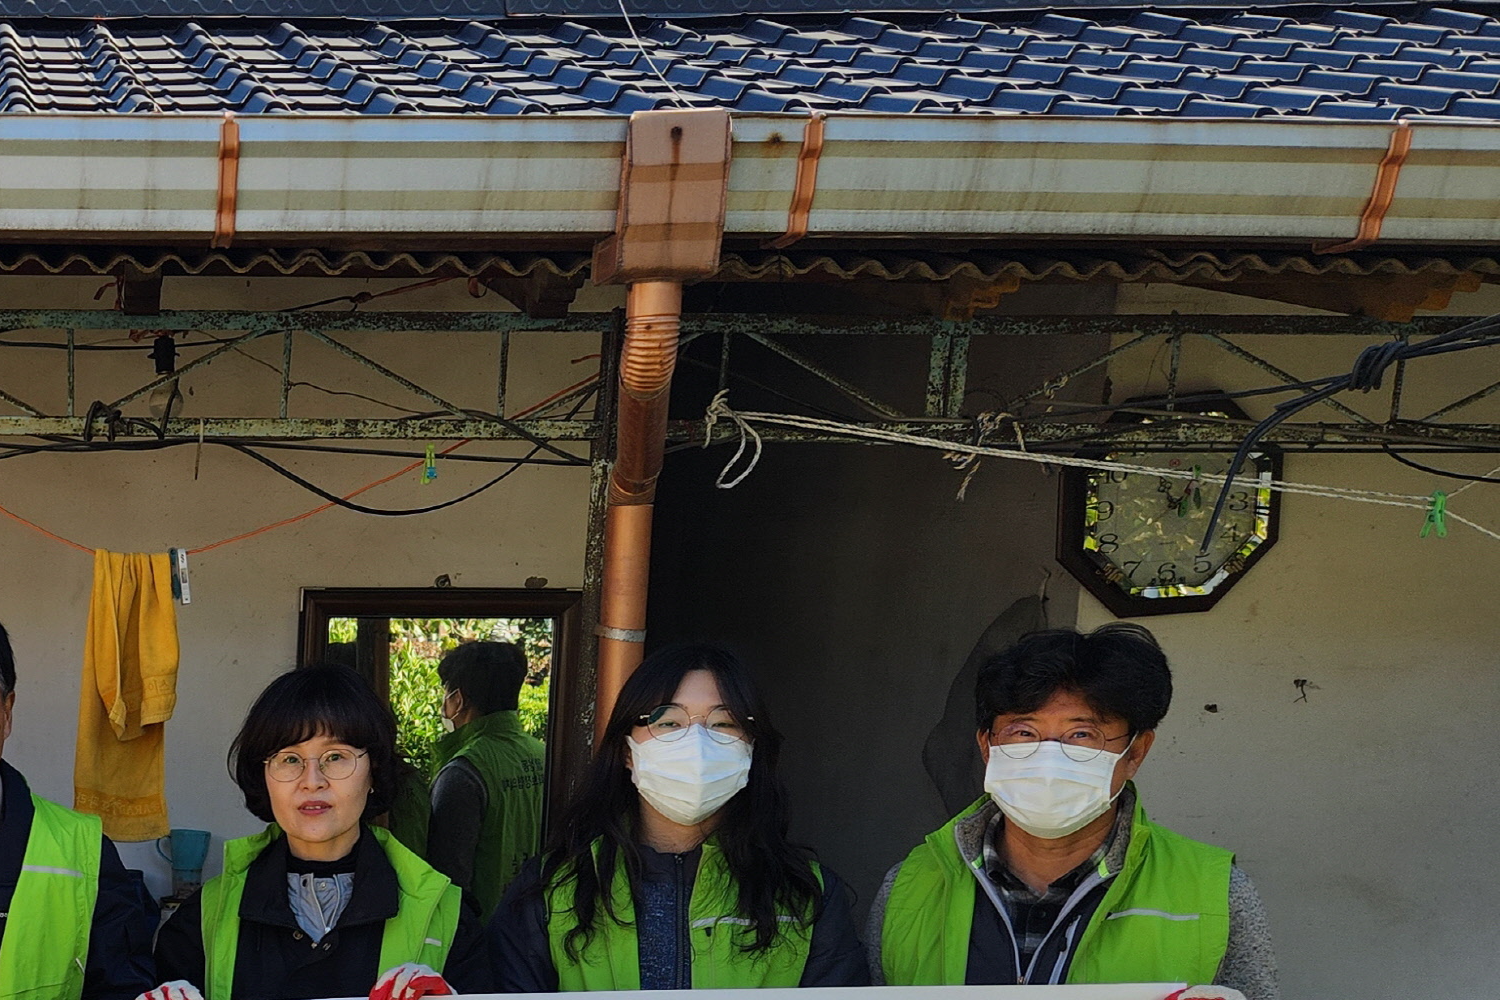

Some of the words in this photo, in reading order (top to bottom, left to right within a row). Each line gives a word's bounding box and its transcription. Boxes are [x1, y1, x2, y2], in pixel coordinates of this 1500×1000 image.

[1229, 491, 1249, 511] 3
[1220, 523, 1239, 542] 4
[1100, 533, 1119, 553] 8
[1123, 560, 1142, 579] 7
[1157, 562, 1176, 583] 6
[1193, 552, 1212, 573] 5
